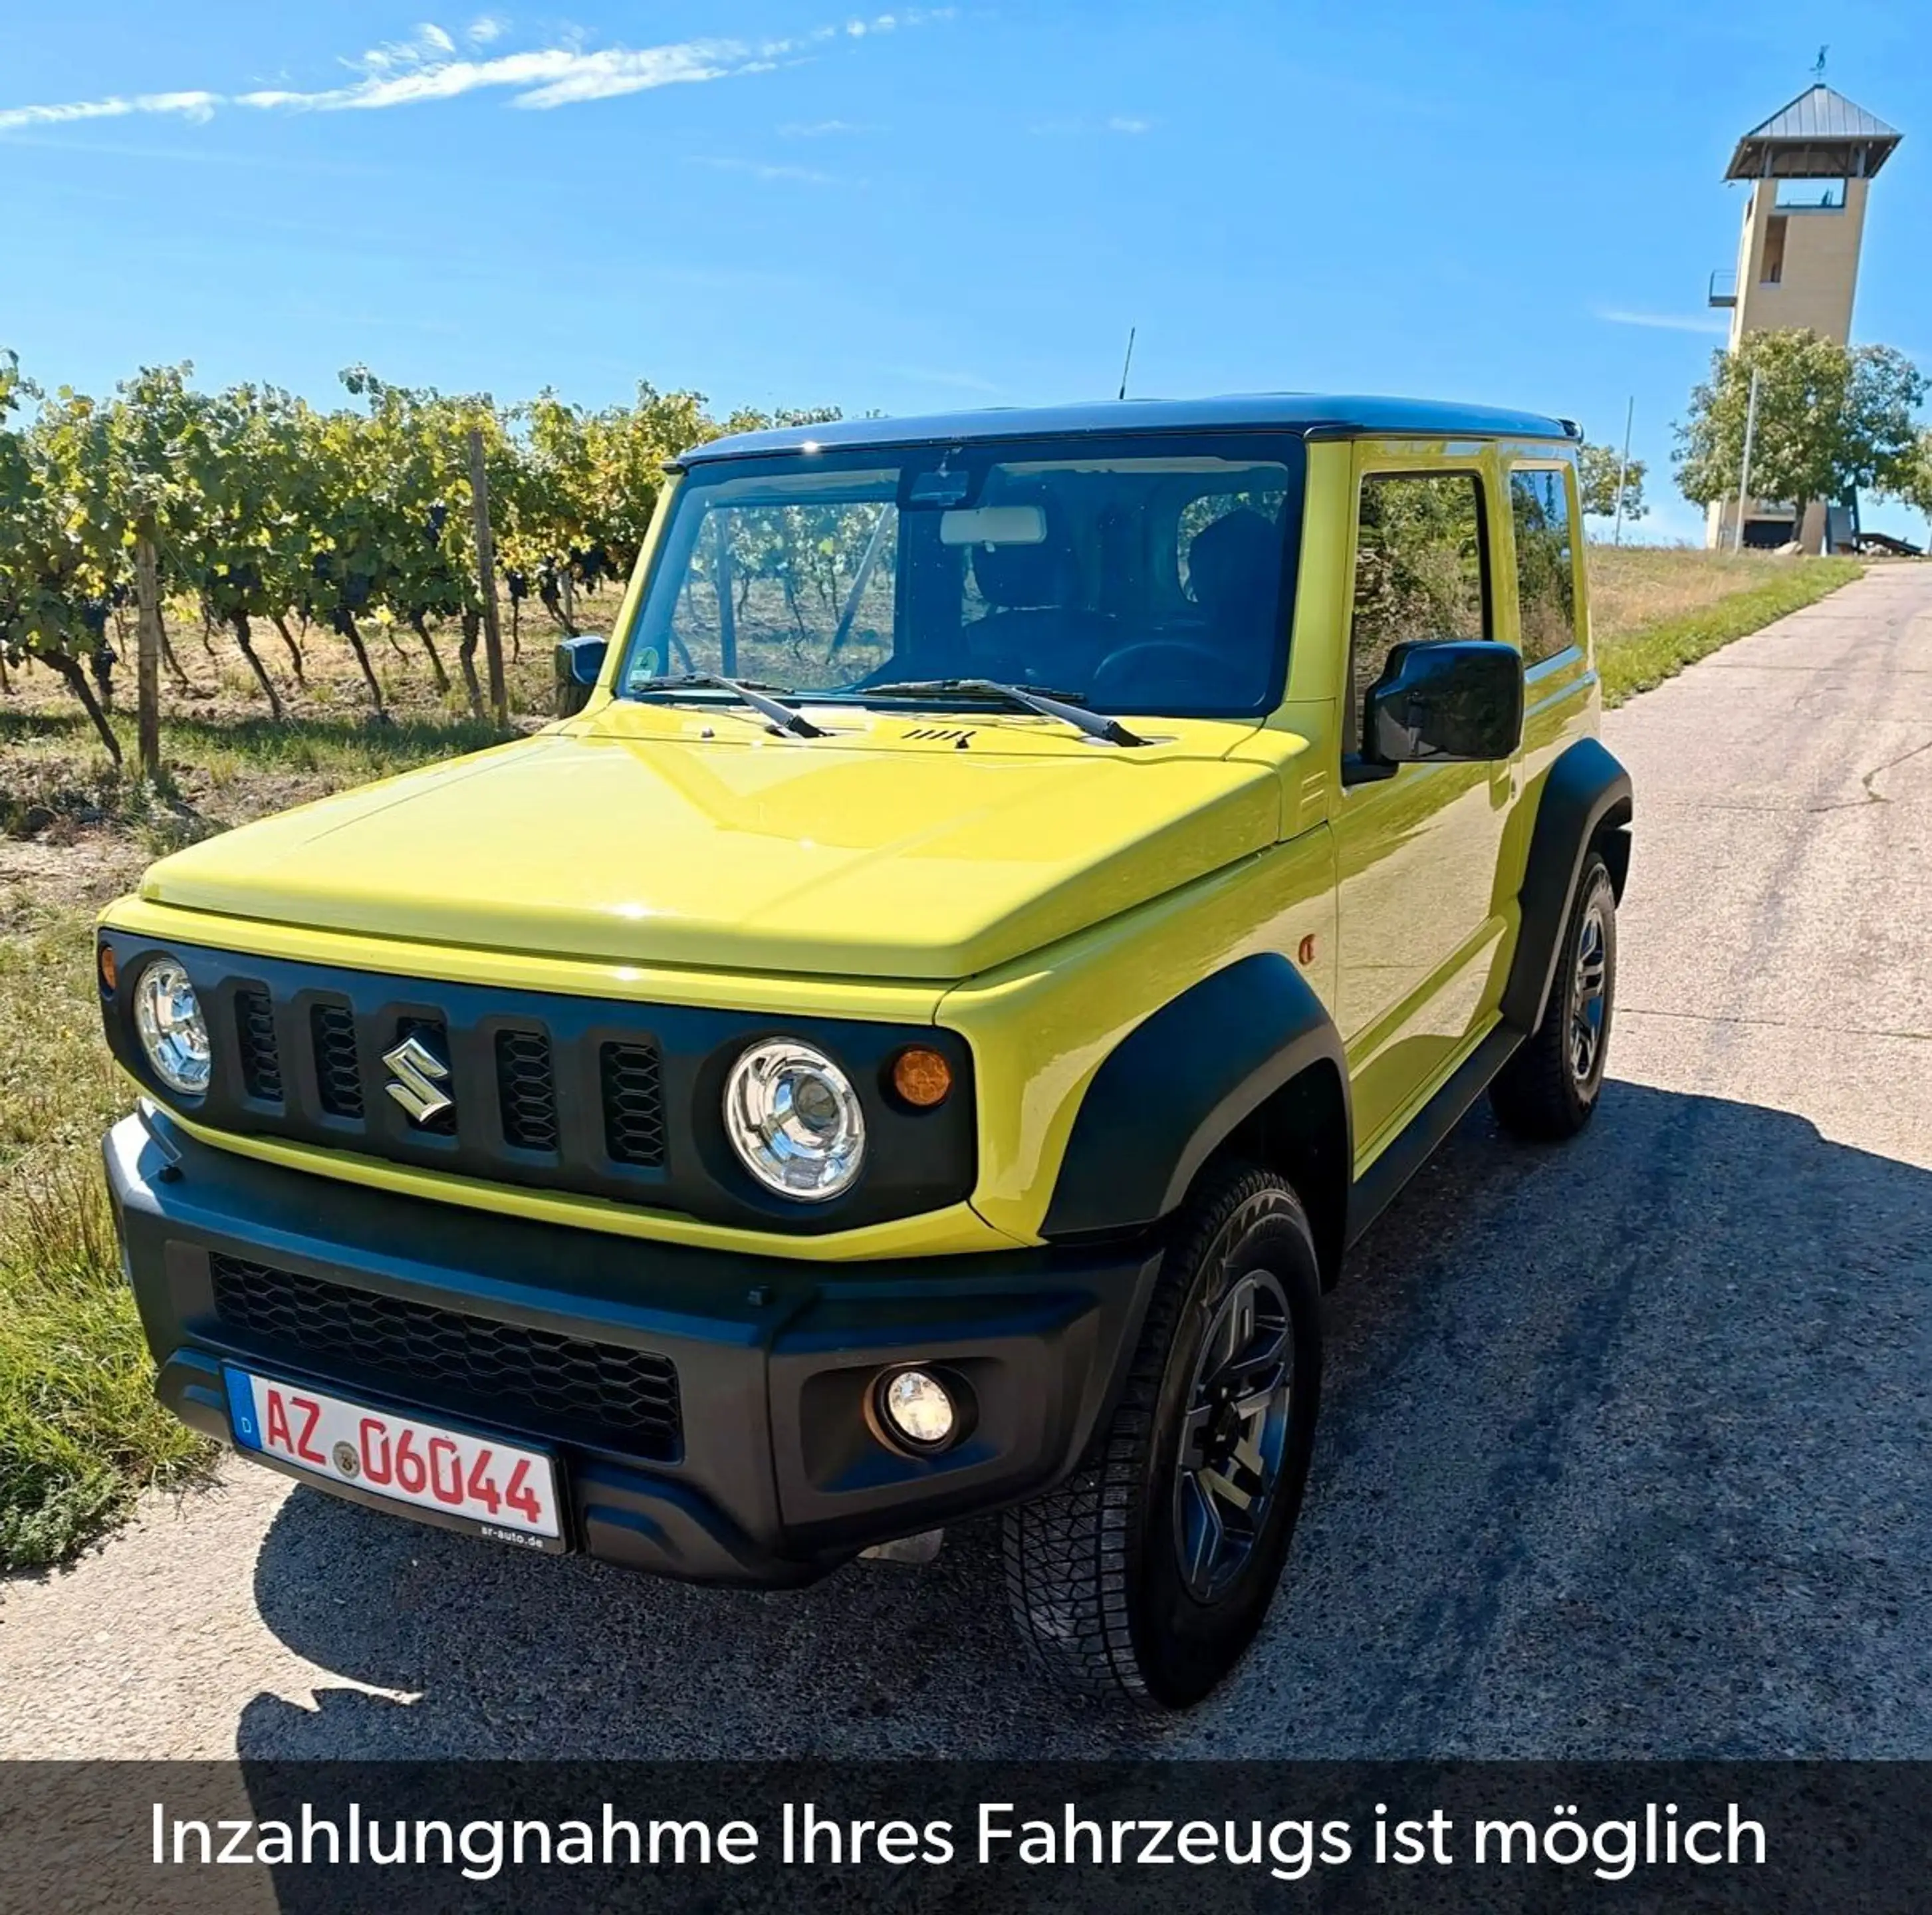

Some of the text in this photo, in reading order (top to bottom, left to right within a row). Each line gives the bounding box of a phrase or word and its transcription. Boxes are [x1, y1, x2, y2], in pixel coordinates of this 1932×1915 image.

[241, 1417, 251, 1434] D
[268, 1388, 541, 1523] AZ 06044
